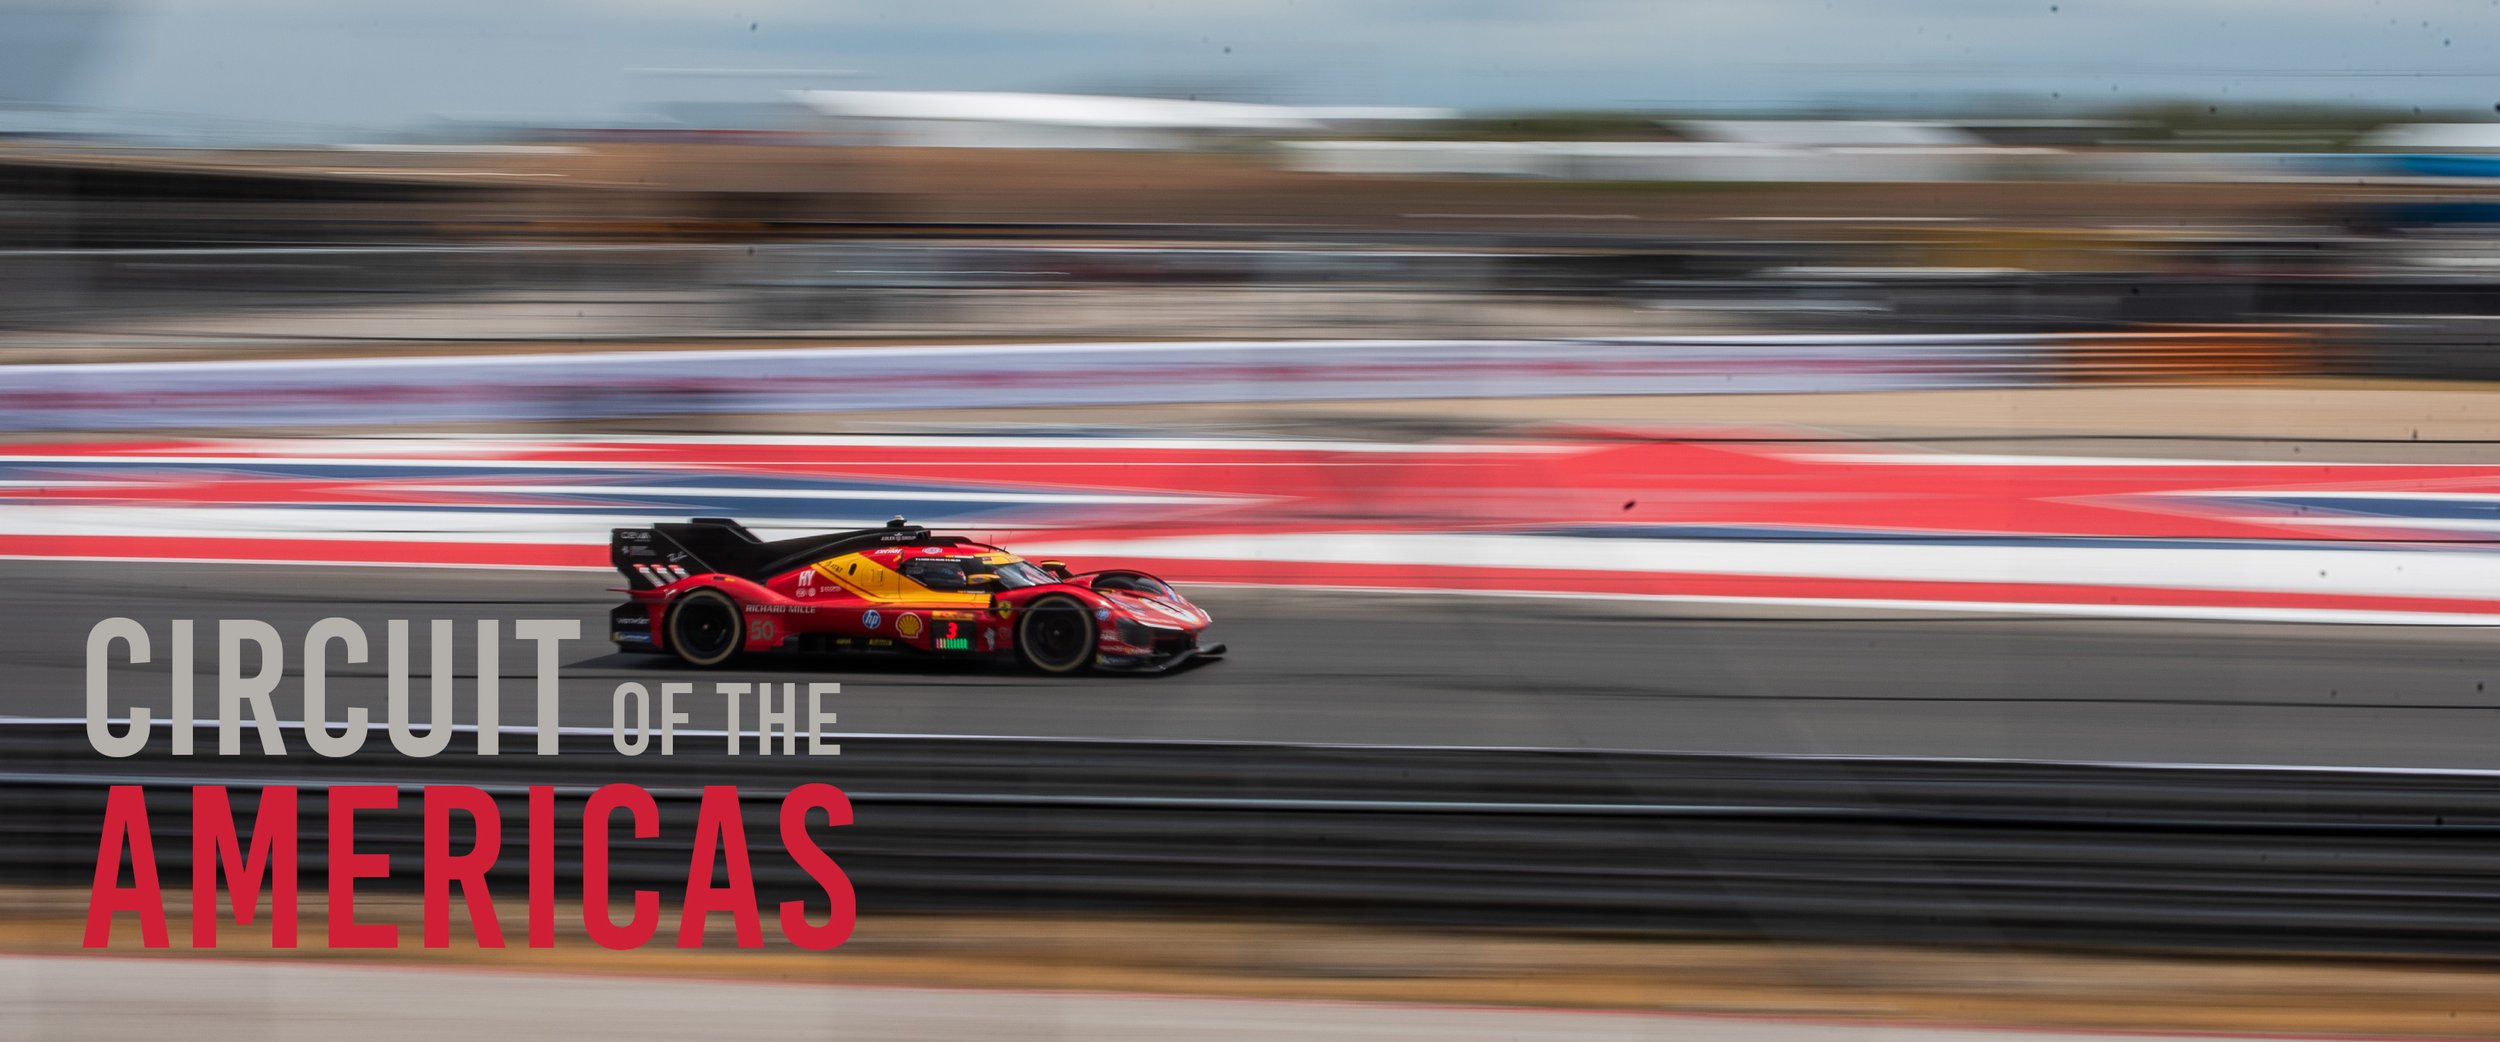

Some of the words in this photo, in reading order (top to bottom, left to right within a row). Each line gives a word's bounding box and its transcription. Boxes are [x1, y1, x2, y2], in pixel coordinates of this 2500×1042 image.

[745, 604, 786, 614] RICHARD
[788, 605, 816, 614] MILLE
[864, 610, 880, 629] hp
[750, 619, 775, 641] 50
[946, 622, 958, 639] 3
